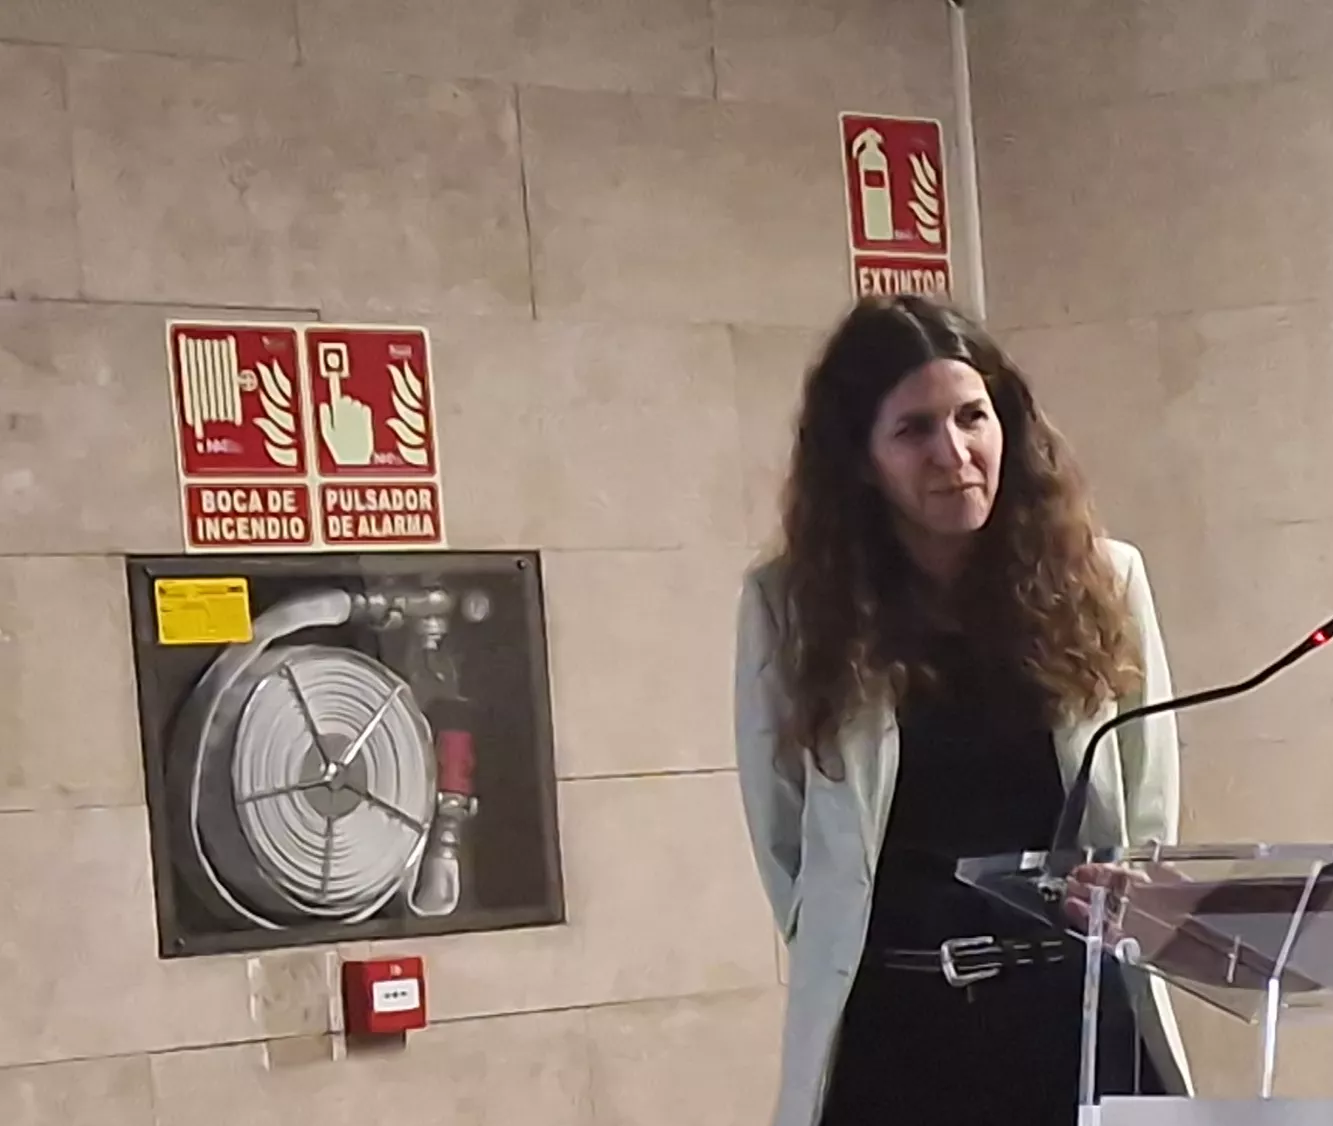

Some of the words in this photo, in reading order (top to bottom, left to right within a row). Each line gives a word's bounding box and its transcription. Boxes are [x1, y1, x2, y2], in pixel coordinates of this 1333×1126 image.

[859, 266, 946, 298] EXTINTOR
[201, 489, 263, 514] BOCA
[267, 489, 297, 513] DE
[325, 488, 433, 513] PULSADOR
[196, 516, 306, 541] INCENDIO
[328, 514, 354, 538] DE
[357, 513, 436, 538] ALARMA
